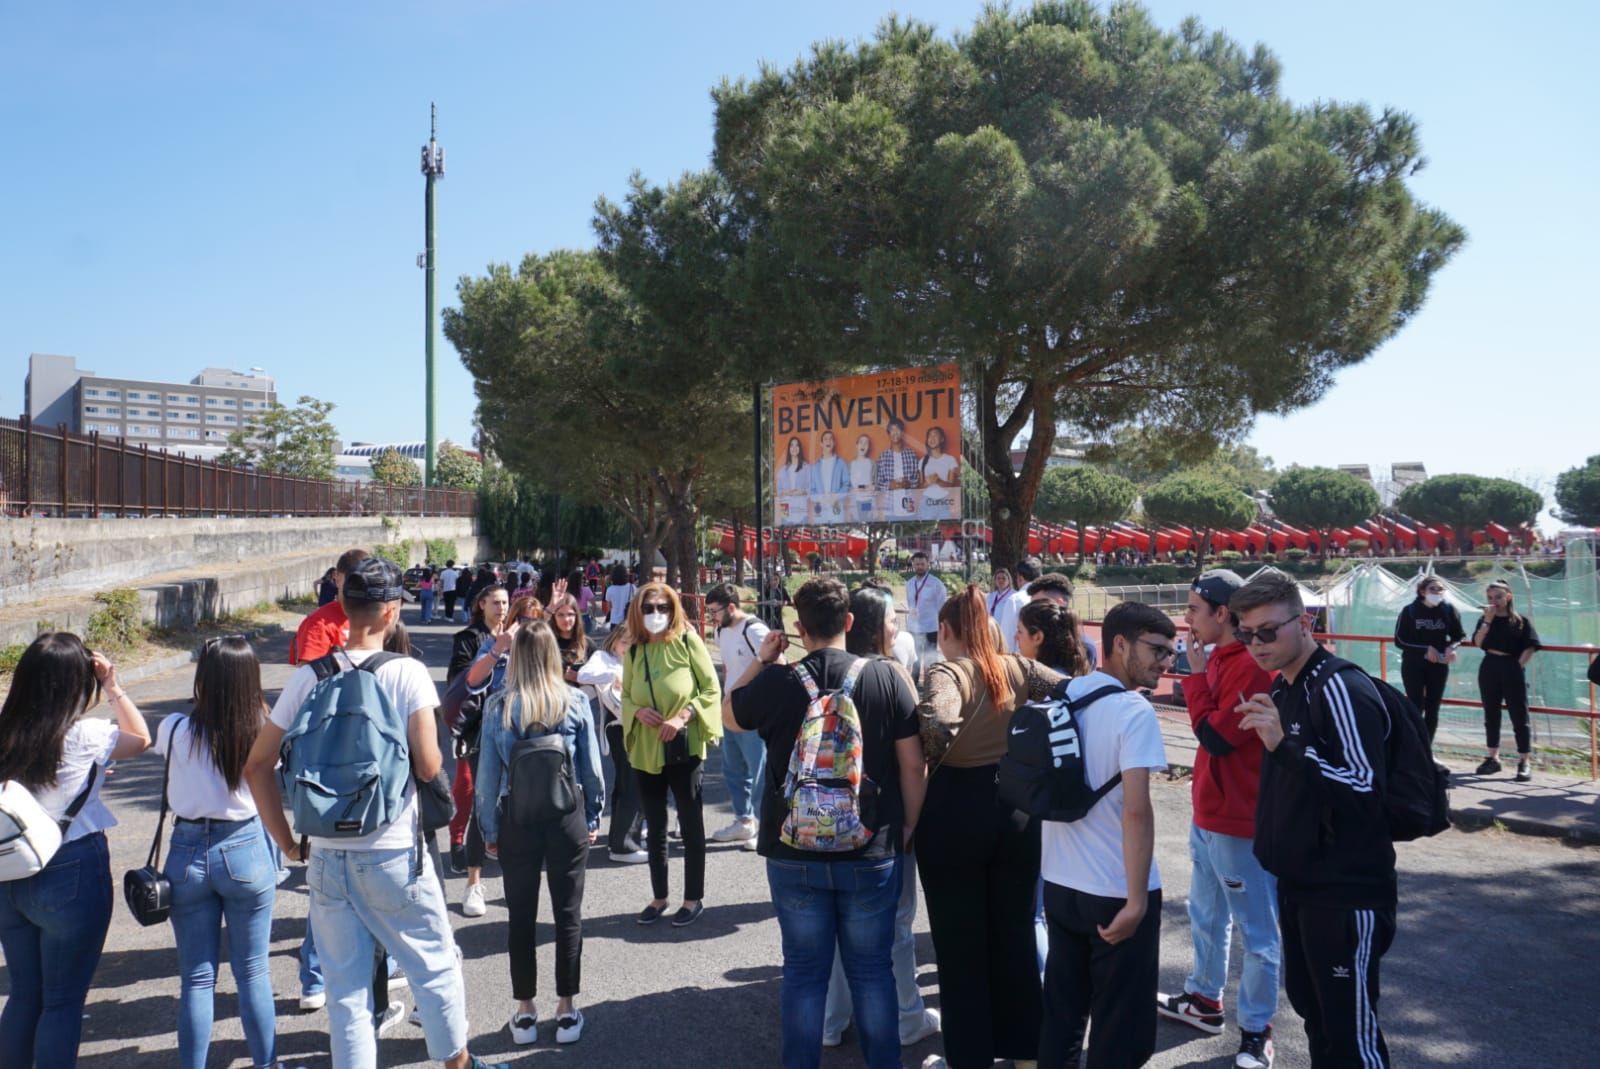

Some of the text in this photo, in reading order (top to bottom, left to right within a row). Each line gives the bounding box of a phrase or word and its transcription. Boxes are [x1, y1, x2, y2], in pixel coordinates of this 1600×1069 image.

[876, 375, 916, 388] 17-18-19
[777, 387, 955, 435] BENVENUTI
[1415, 618, 1446, 630] FILA
